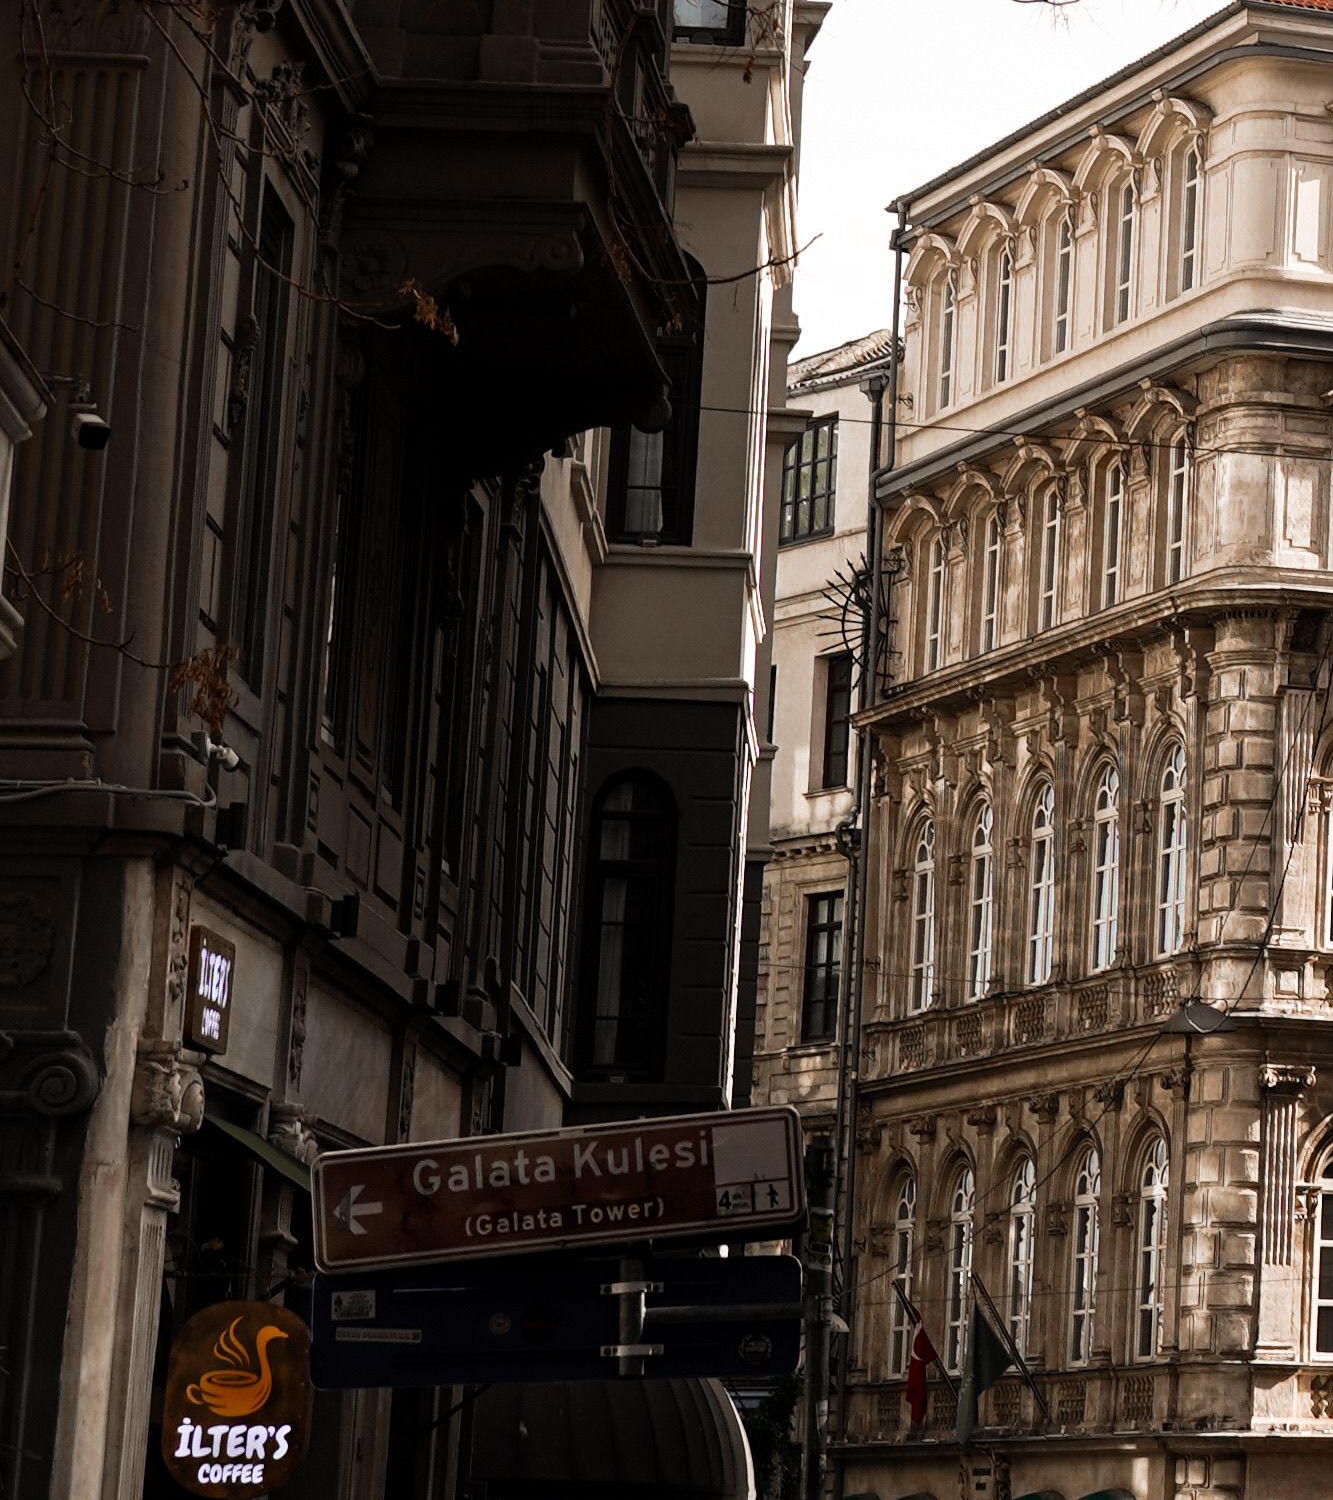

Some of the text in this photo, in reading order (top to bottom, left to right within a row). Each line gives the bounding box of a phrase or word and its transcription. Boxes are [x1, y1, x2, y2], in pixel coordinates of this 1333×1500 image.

[413, 1131, 711, 1197] Galata Kulesi
[465, 1197, 664, 1238] (Galata Tower)
[719, 1190, 731, 1210] 4
[174, 1416, 292, 1460] İLTER'S
[198, 1462, 265, 1485] COFFEE
